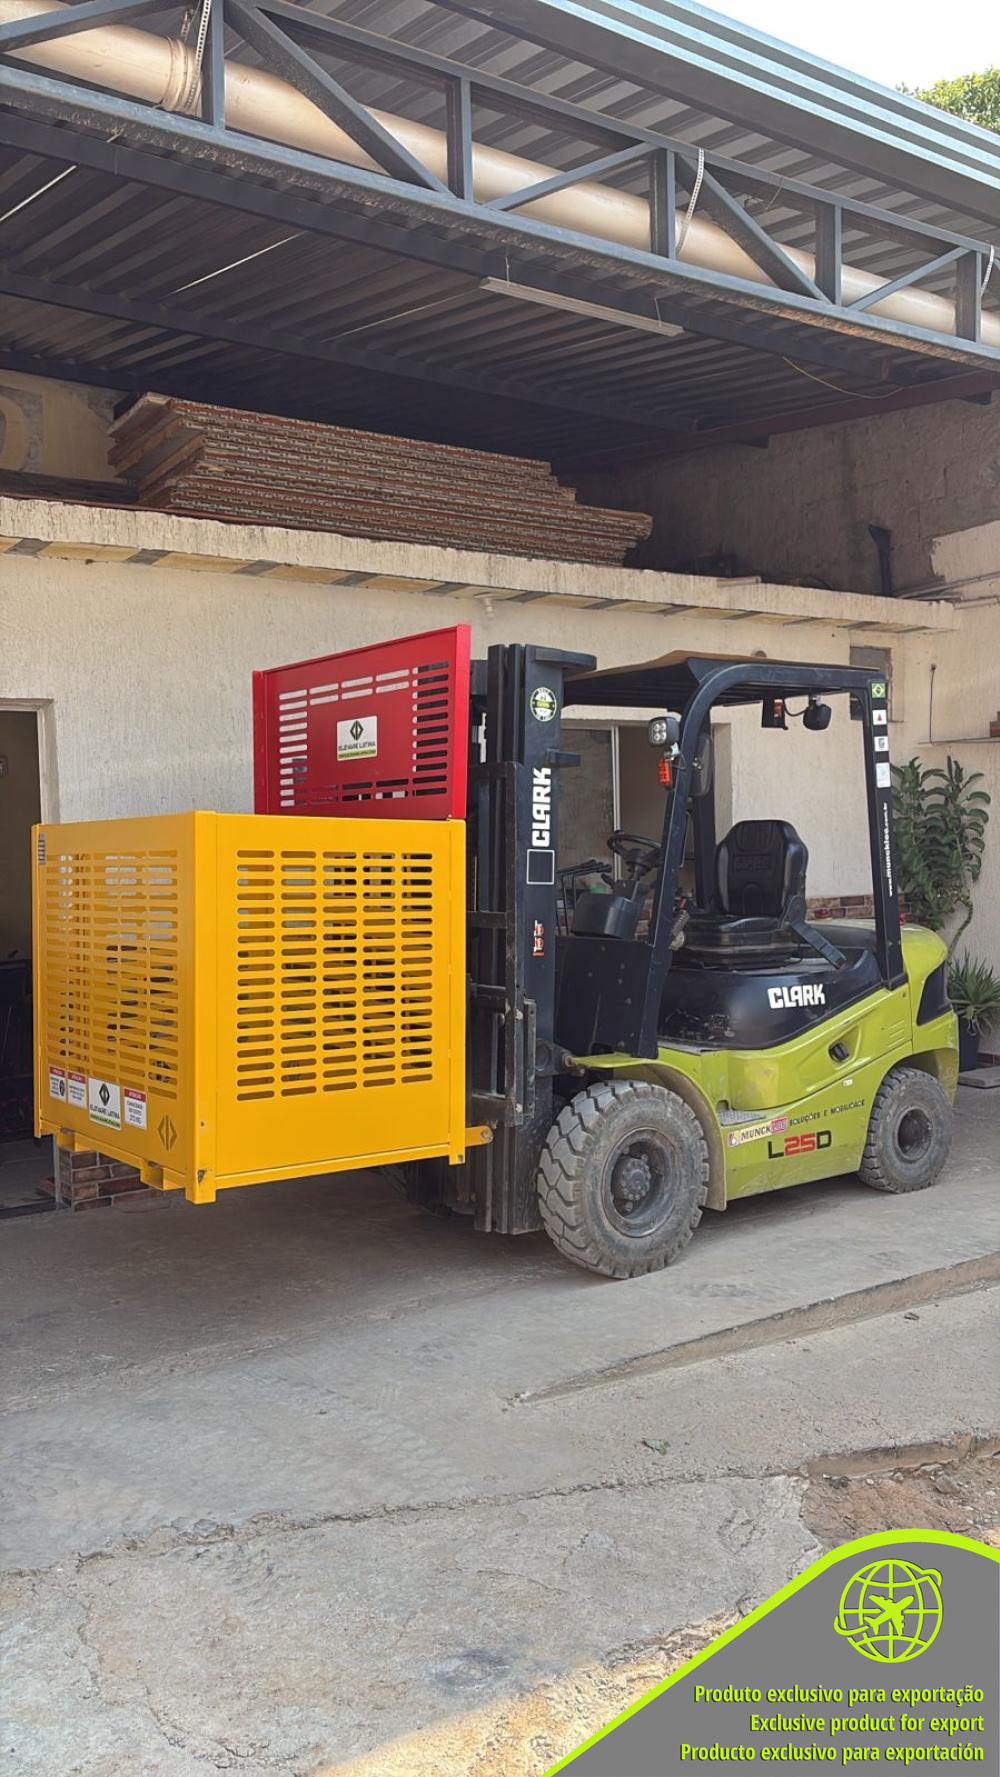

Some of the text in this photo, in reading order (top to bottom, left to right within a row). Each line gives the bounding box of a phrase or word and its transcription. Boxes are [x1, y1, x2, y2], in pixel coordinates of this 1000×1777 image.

[531, 767, 552, 848] CLARK
[767, 983, 826, 1009] CLARK
[789, 1111, 821, 1126] SOLUÇÕES
[830, 1099, 866, 1115] MOBILIDADE
[768, 1129, 832, 1160] L25D
